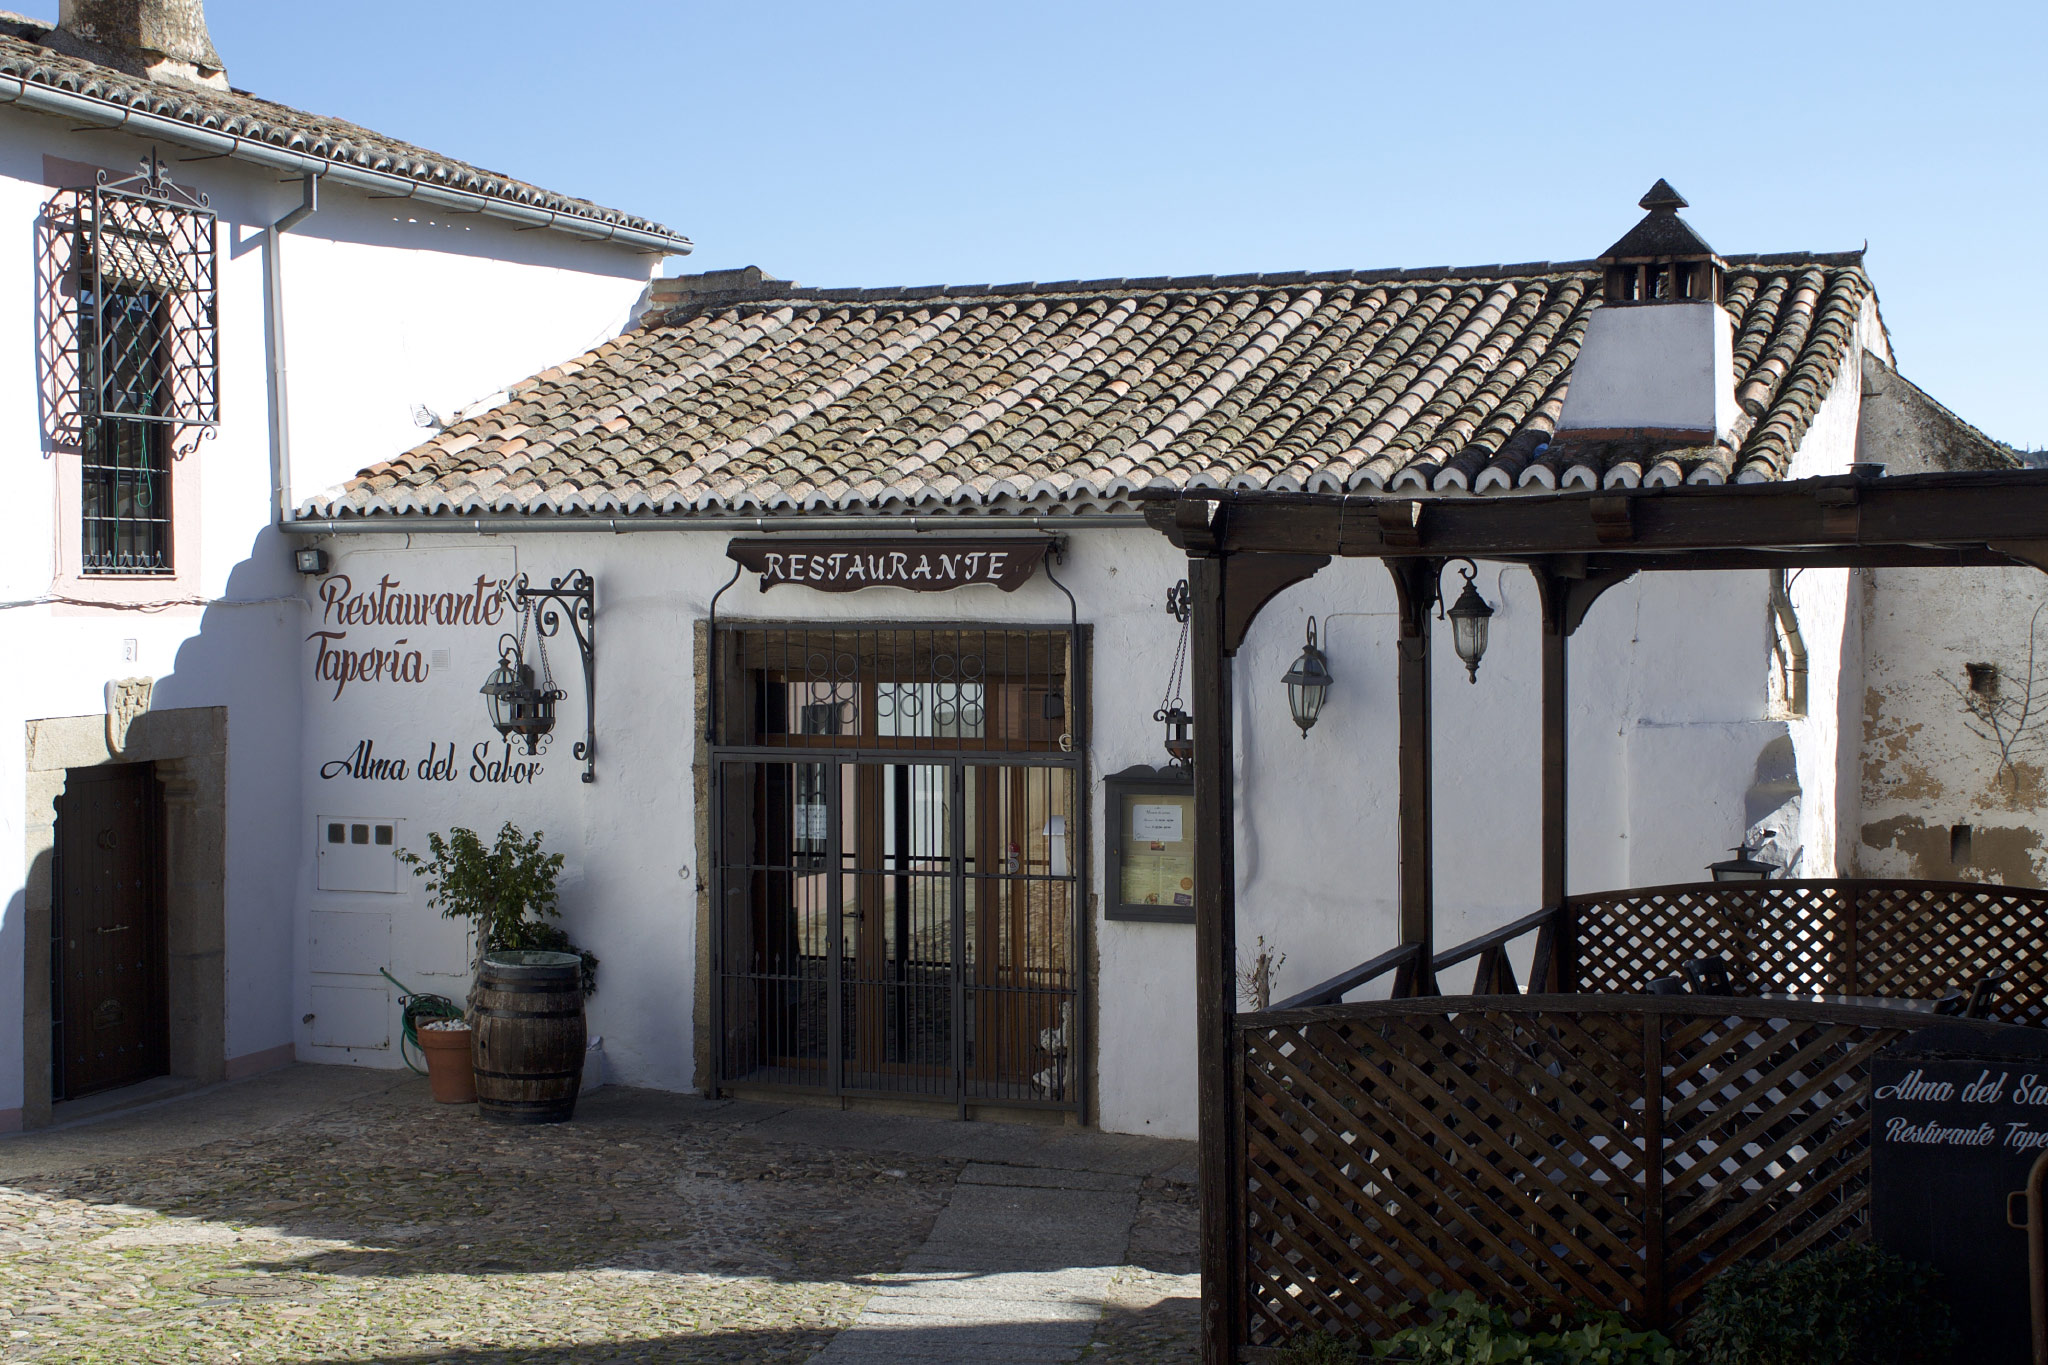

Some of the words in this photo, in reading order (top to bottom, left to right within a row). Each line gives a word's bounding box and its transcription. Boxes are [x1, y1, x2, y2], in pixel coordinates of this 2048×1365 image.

[765, 552, 1009, 580] RESTAURANTE
[319, 573, 504, 626] Restaurante
[305, 631, 429, 702] Tapería
[320, 740, 410, 781] Alma
[418, 742, 458, 782] del
[469, 741, 545, 784] Sabor
[1874, 1069, 1955, 1102] Alma
[1961, 1069, 2008, 1103] del
[2013, 1074, 2048, 1105] Sa
[2003, 1122, 2048, 1155] Tape
